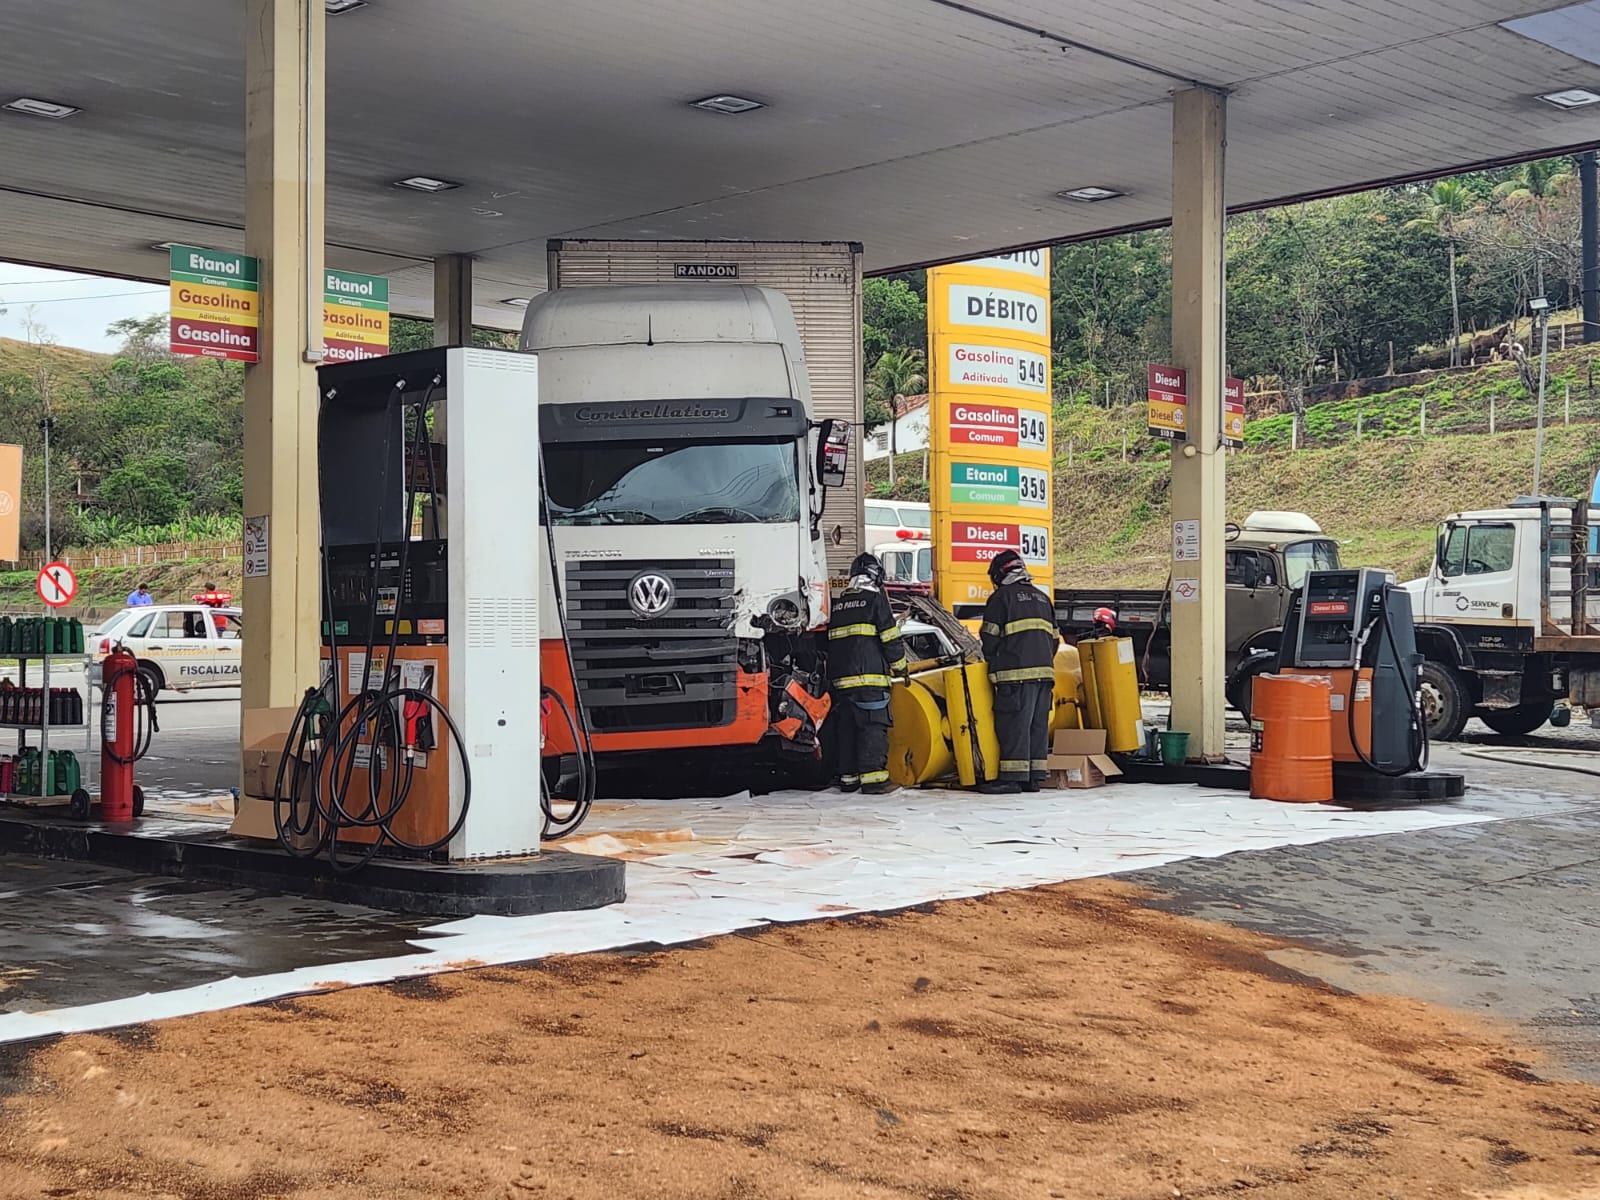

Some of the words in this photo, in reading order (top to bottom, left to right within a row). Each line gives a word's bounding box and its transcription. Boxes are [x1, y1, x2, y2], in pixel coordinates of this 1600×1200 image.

[189, 253, 240, 275] Etanol
[677, 265, 736, 276] RANDON
[202, 276, 228, 287] Comum
[326, 275, 373, 296] Etanol
[178, 288, 251, 311] Gasolina
[966, 292, 1038, 324] DÉBITO
[177, 324, 251, 347] Gasolina
[201, 348, 228, 358] Comum
[955, 348, 1014, 366] Gasolina
[962, 372, 1009, 384] Aditivada
[1019, 359, 1045, 384] 549
[1154, 372, 1180, 388] Diesel
[575, 406, 729, 421] Constellation
[955, 407, 1015, 425] Gasolina
[1150, 408, 1174, 422] Diesel
[968, 430, 1005, 443] Comum
[1020, 417, 1045, 442] 549
[966, 467, 1008, 483] Etanol
[968, 490, 1005, 502] Comum
[1021, 475, 1046, 501] 359
[966, 526, 1008, 542] Diesel
[1022, 533, 1046, 558] 549
[1373, 594, 1381, 603] D
[180, 664, 242, 676] FISCALIZA
